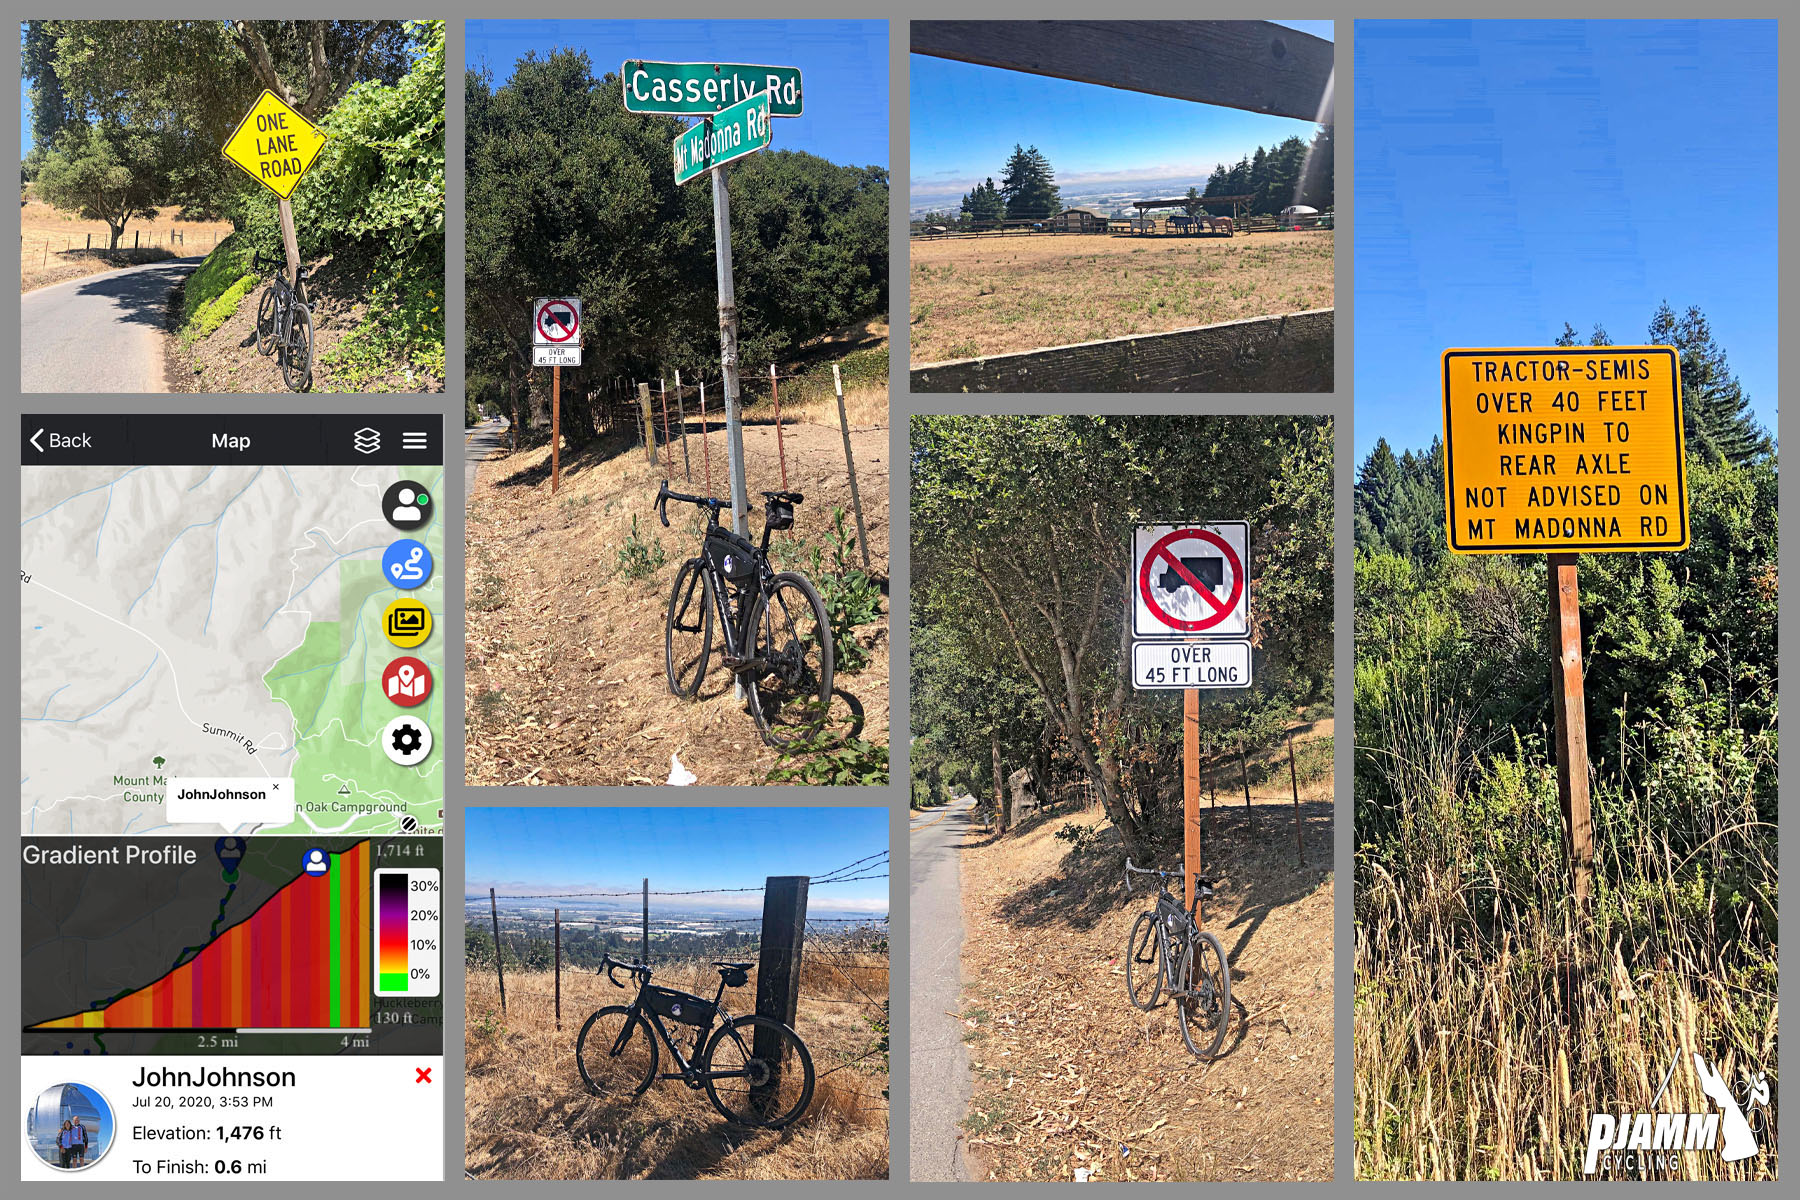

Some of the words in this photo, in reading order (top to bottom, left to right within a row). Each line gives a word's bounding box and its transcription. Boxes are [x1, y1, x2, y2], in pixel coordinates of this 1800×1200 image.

[632, 70, 756, 103] Casserly
[766, 74, 796, 105] Rd
[256, 112, 288, 132] ONE
[256, 134, 298, 156] LANE
[676, 143, 688, 173] Mt
[690, 121, 741, 166] Madonna
[747, 104, 765, 141] Rd
[260, 157, 301, 179] ROAD
[1472, 359, 1650, 382] TRACTOR-SEMIS
[1476, 392, 1533, 413] OVER
[1552, 391, 1579, 412] 40
[1598, 390, 1647, 411] FEET
[1498, 422, 1585, 444] KINGPIN
[1604, 422, 1630, 443] TO
[49, 432, 92, 448] Back
[211, 433, 251, 451] Map
[1500, 454, 1556, 476] REAR
[1576, 453, 1630, 475] AXLE
[1466, 487, 1507, 508] NOT
[1528, 485, 1620, 507] ADVISED
[1640, 484, 1668, 505] ON
[1468, 519, 1495, 540] MT
[1516, 517, 1622, 539] MADONNA
[1641, 516, 1668, 537] RD
[1171, 648, 1211, 663] OVER
[1146, 668, 1165, 682] 45
[1172, 667, 1191, 682] FT
[1198, 667, 1238, 682] LONG
[202, 722, 244, 744] Summit
[243, 740, 257, 755] Rd
[113, 775, 149, 786] Mount
[123, 792, 164, 805] County
[178, 789, 266, 800] JohnJohnson
[306, 802, 328, 812] Oak
[331, 802, 407, 814] Campground
[22, 845, 118, 865] Gradient
[126, 844, 197, 865] Profile
[377, 845, 410, 857] 1,714
[415, 844, 424, 856] ft
[411, 881, 439, 892] 30%
[411, 910, 438, 921] 20%
[411, 940, 436, 950] 10%
[411, 969, 430, 979] 0%
[377, 1012, 399, 1023] 130
[403, 1012, 412, 1023] ft
[198, 1035, 217, 1048] 2.5
[221, 1035, 238, 1048] mi
[341, 1035, 349, 1048] 4
[353, 1035, 369, 1048] mi
[132, 1066, 296, 1087] JohnJohnson
[132, 1096, 150, 1108] Jul
[155, 1096, 175, 1110] 20,
[179, 1096, 216, 1110] 2020,
[219, 1096, 248, 1108] 3:53
[252, 1096, 273, 1107] PM
[133, 1125, 211, 1141] Elevation:
[216, 1126, 264, 1143] 1,476
[269, 1125, 282, 1141] ft
[133, 1160, 152, 1174] To
[157, 1159, 209, 1174] Finish:
[214, 1160, 241, 1174] 0.6
[248, 1160, 267, 1174] mi
